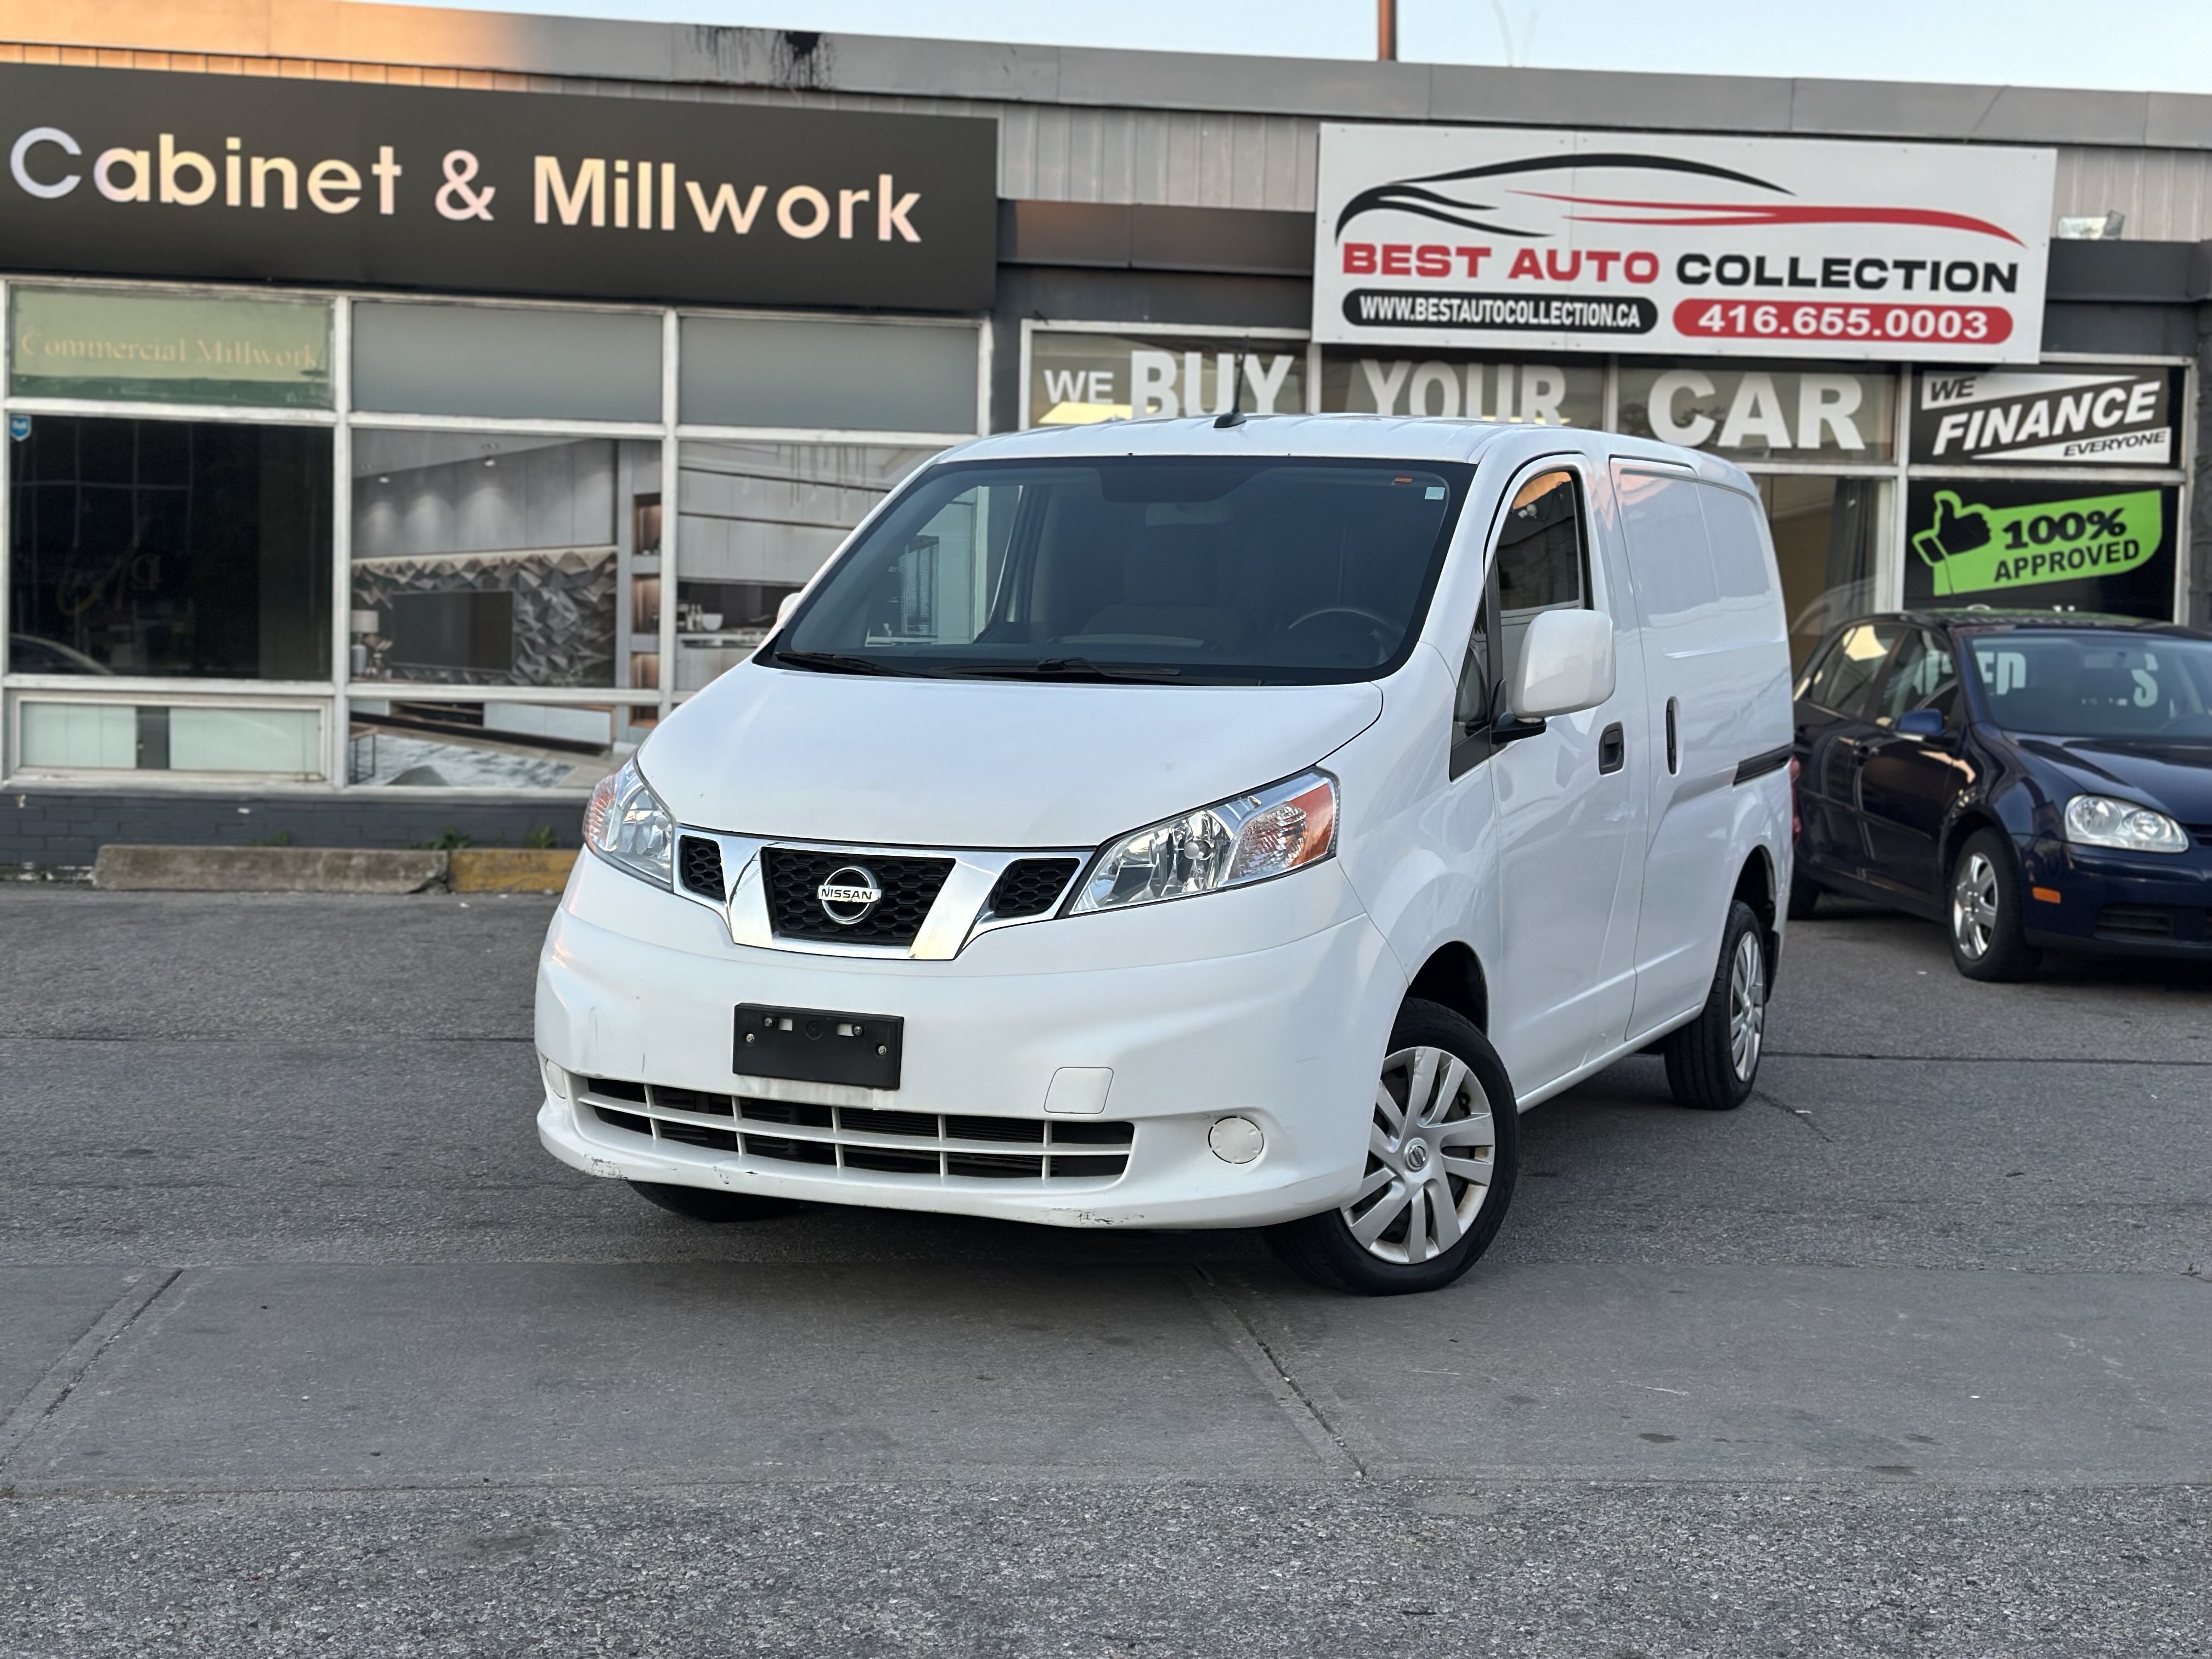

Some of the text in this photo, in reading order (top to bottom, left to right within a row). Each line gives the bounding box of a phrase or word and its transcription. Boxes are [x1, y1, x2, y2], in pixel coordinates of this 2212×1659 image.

[10, 127, 922, 242] Cabinet & Millwork
[1342, 242, 2018, 293] BEST AUTO COLLECTION
[1359, 295, 1640, 328] WWW.BESTAUTOCOLLECTION.CA
[21, 331, 318, 368] Commercial Millwork
[1044, 351, 1866, 449] WE BUY YOUR CAR
[1929, 376, 1976, 402] WE
[1932, 381, 2161, 456] FINANCE
[2063, 430, 2168, 457] EVERYONE
[2002, 507, 2127, 550] 100%
[1994, 539, 2140, 583] APPROVED
[821, 888, 872, 900] NISSAN
